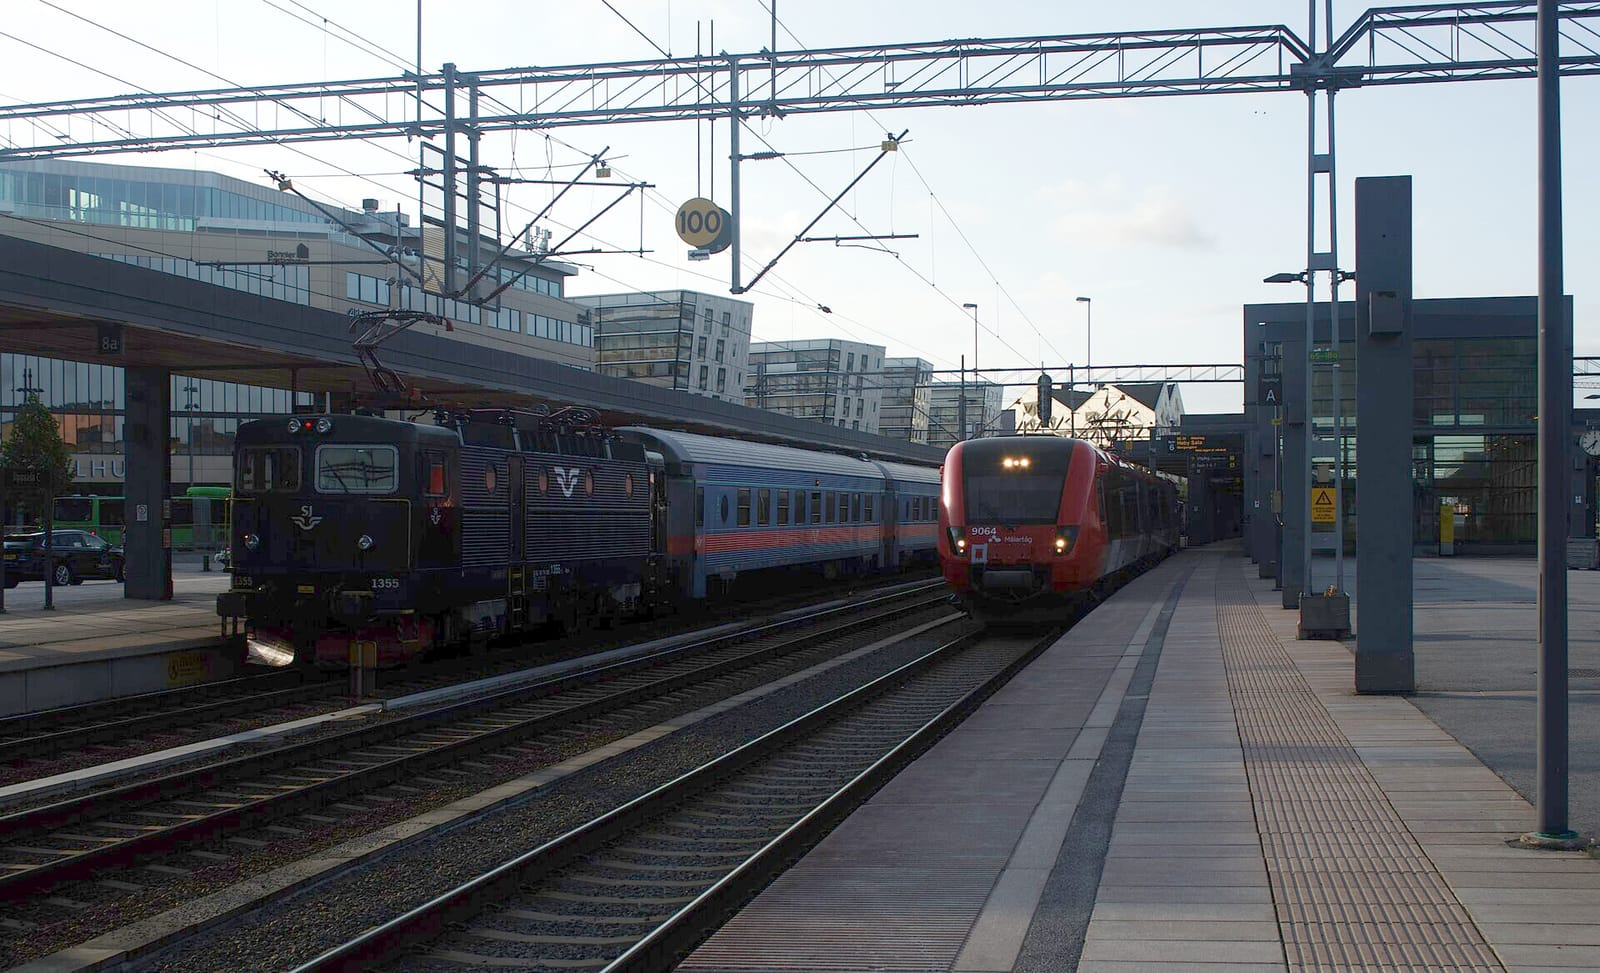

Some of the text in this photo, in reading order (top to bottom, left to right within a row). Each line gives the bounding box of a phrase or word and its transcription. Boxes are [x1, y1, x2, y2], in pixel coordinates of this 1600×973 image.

[679, 210, 721, 234] 100
[103, 337, 119, 350] 8a
[1266, 389, 1276, 401] A
[301, 505, 313, 517] SJ
[971, 527, 997, 536] 9064
[371, 578, 400, 588] 1355
